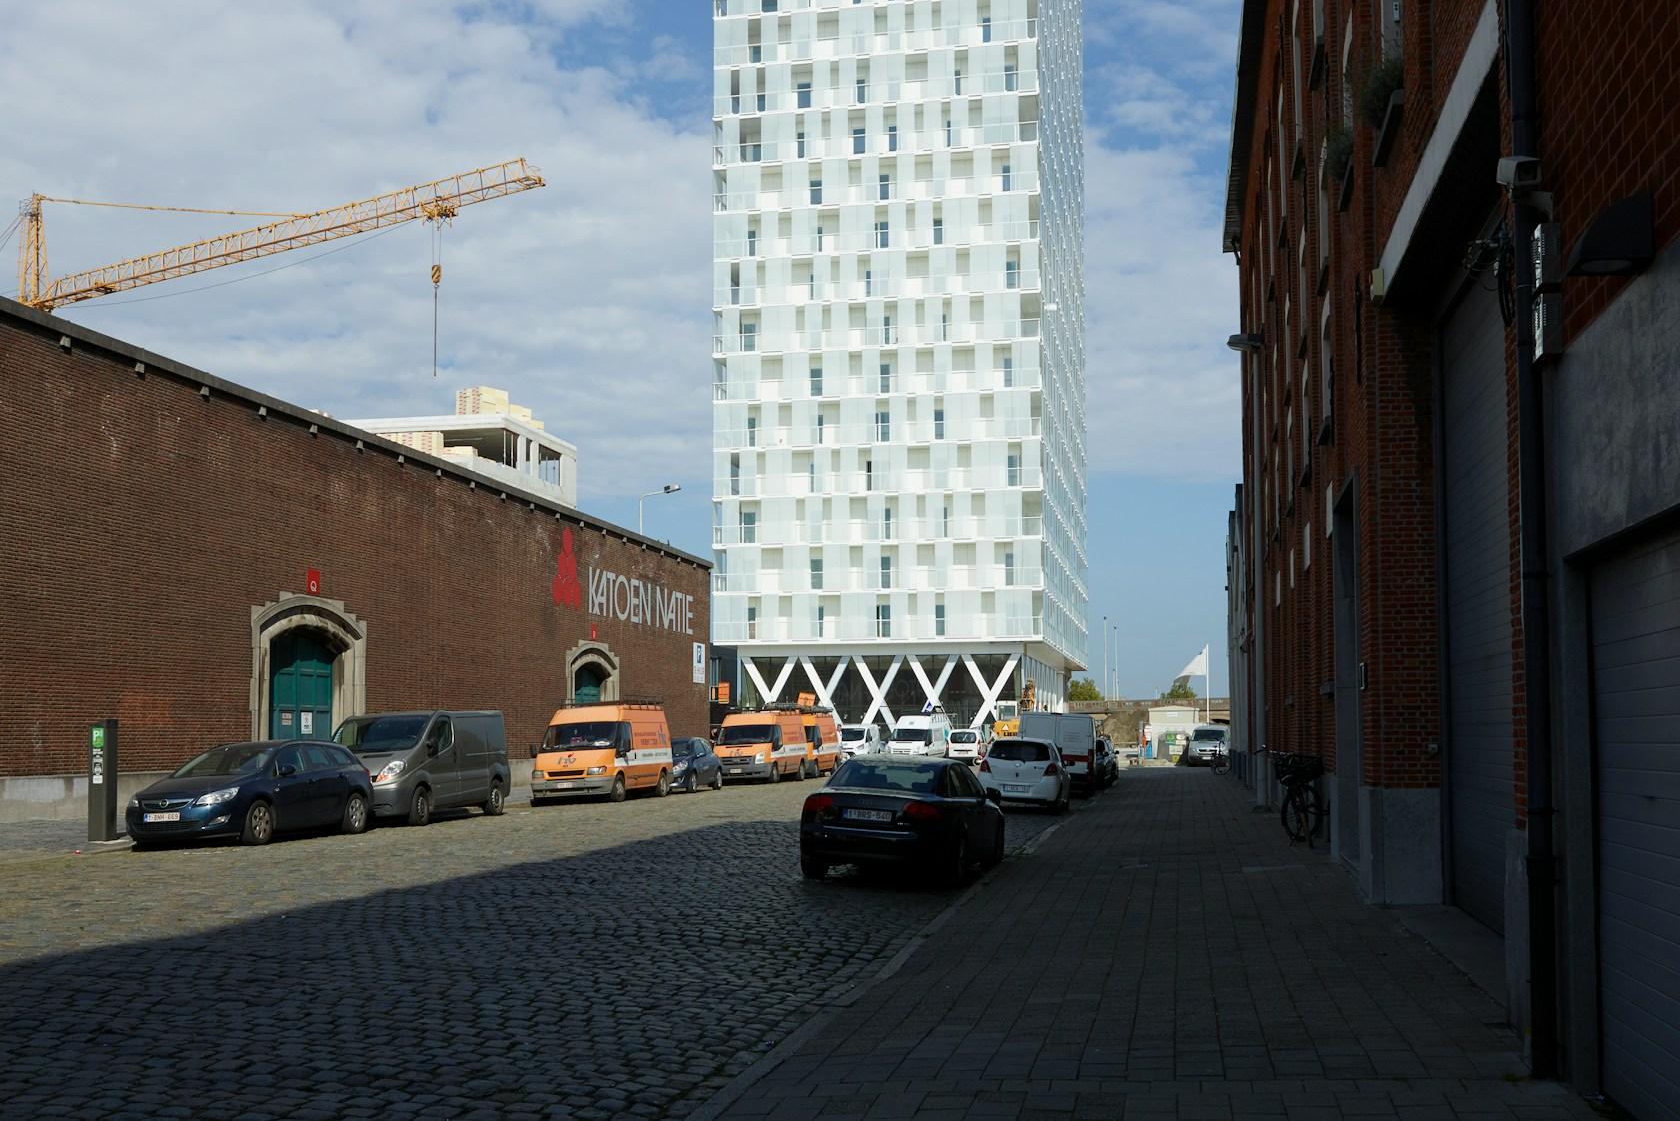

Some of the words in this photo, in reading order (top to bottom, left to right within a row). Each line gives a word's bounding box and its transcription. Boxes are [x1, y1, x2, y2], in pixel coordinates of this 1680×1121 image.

[310, 580, 317, 592] Q
[588, 566, 651, 625] KATOEN
[656, 586, 694, 635] NATIE
[93, 730, 100, 742] P
